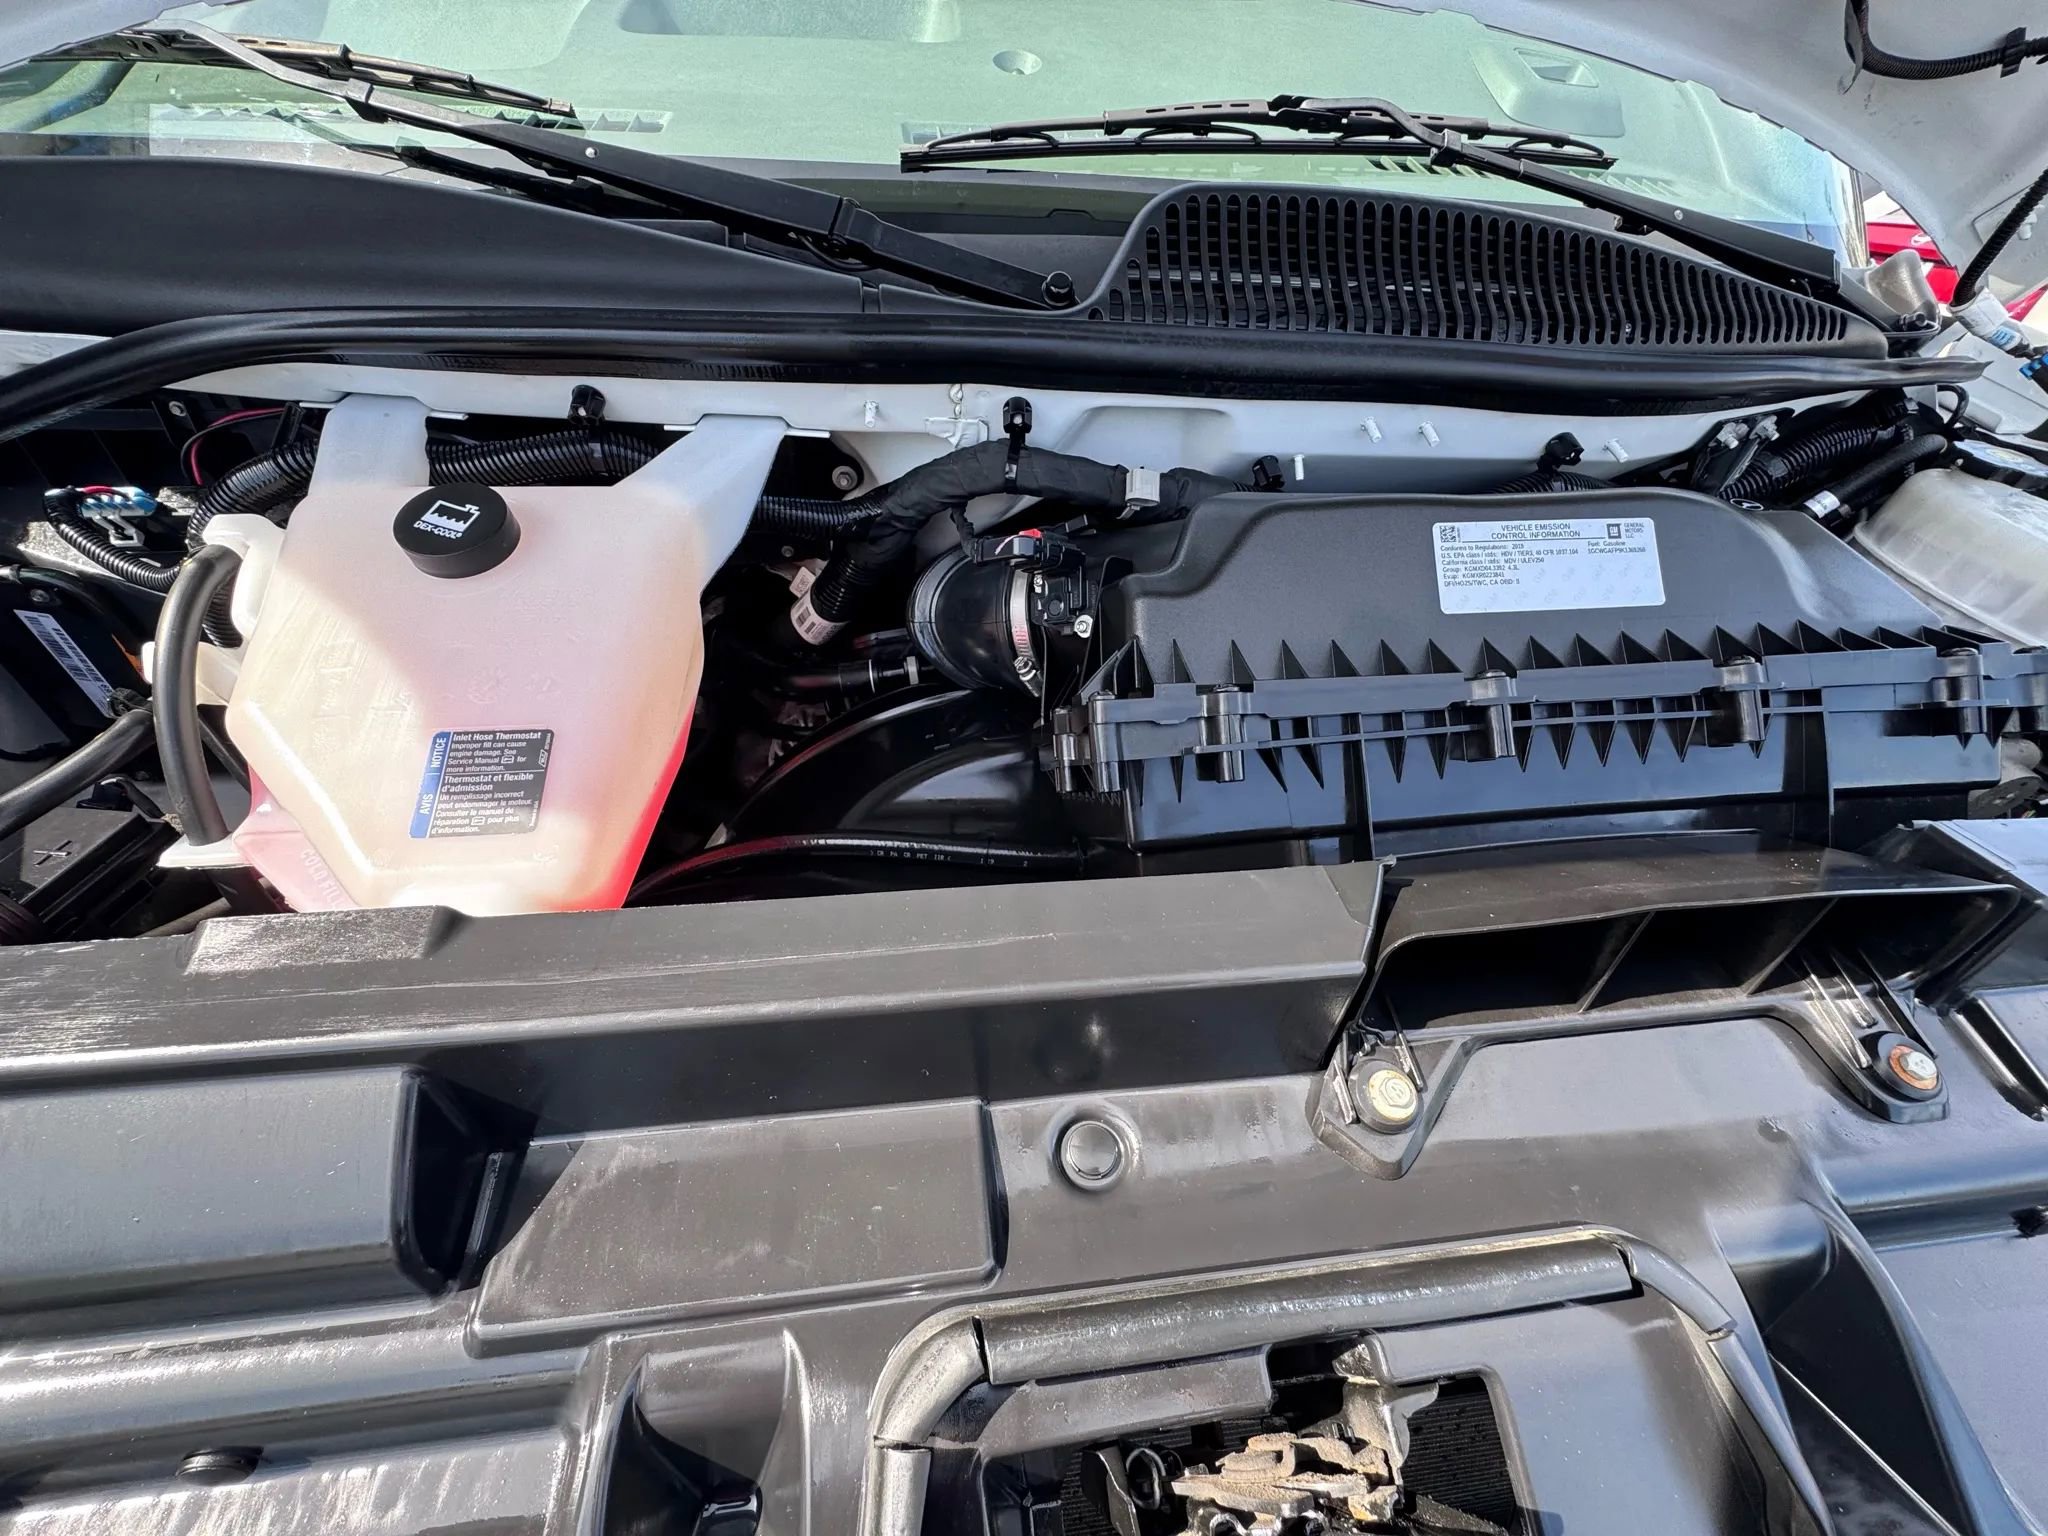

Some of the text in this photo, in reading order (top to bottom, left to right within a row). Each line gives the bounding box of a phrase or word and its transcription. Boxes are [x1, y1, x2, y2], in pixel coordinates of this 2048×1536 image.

[453, 732, 542, 742] Inlet Hose Thermostat
[451, 742, 482, 750] Improper
[430, 737, 447, 768] NOTICE
[444, 775, 492, 784] Thermostat
[503, 773, 534, 781] flexible
[441, 784, 493, 792] d'admission
[450, 792, 493, 801] remplissage
[419, 794, 434, 814] AVIS
[454, 800, 498, 808] endommager
[436, 810, 469, 818] Consulter
[434, 815, 520, 826] réparation pour plus
[300, 849, 329, 881] COLD
